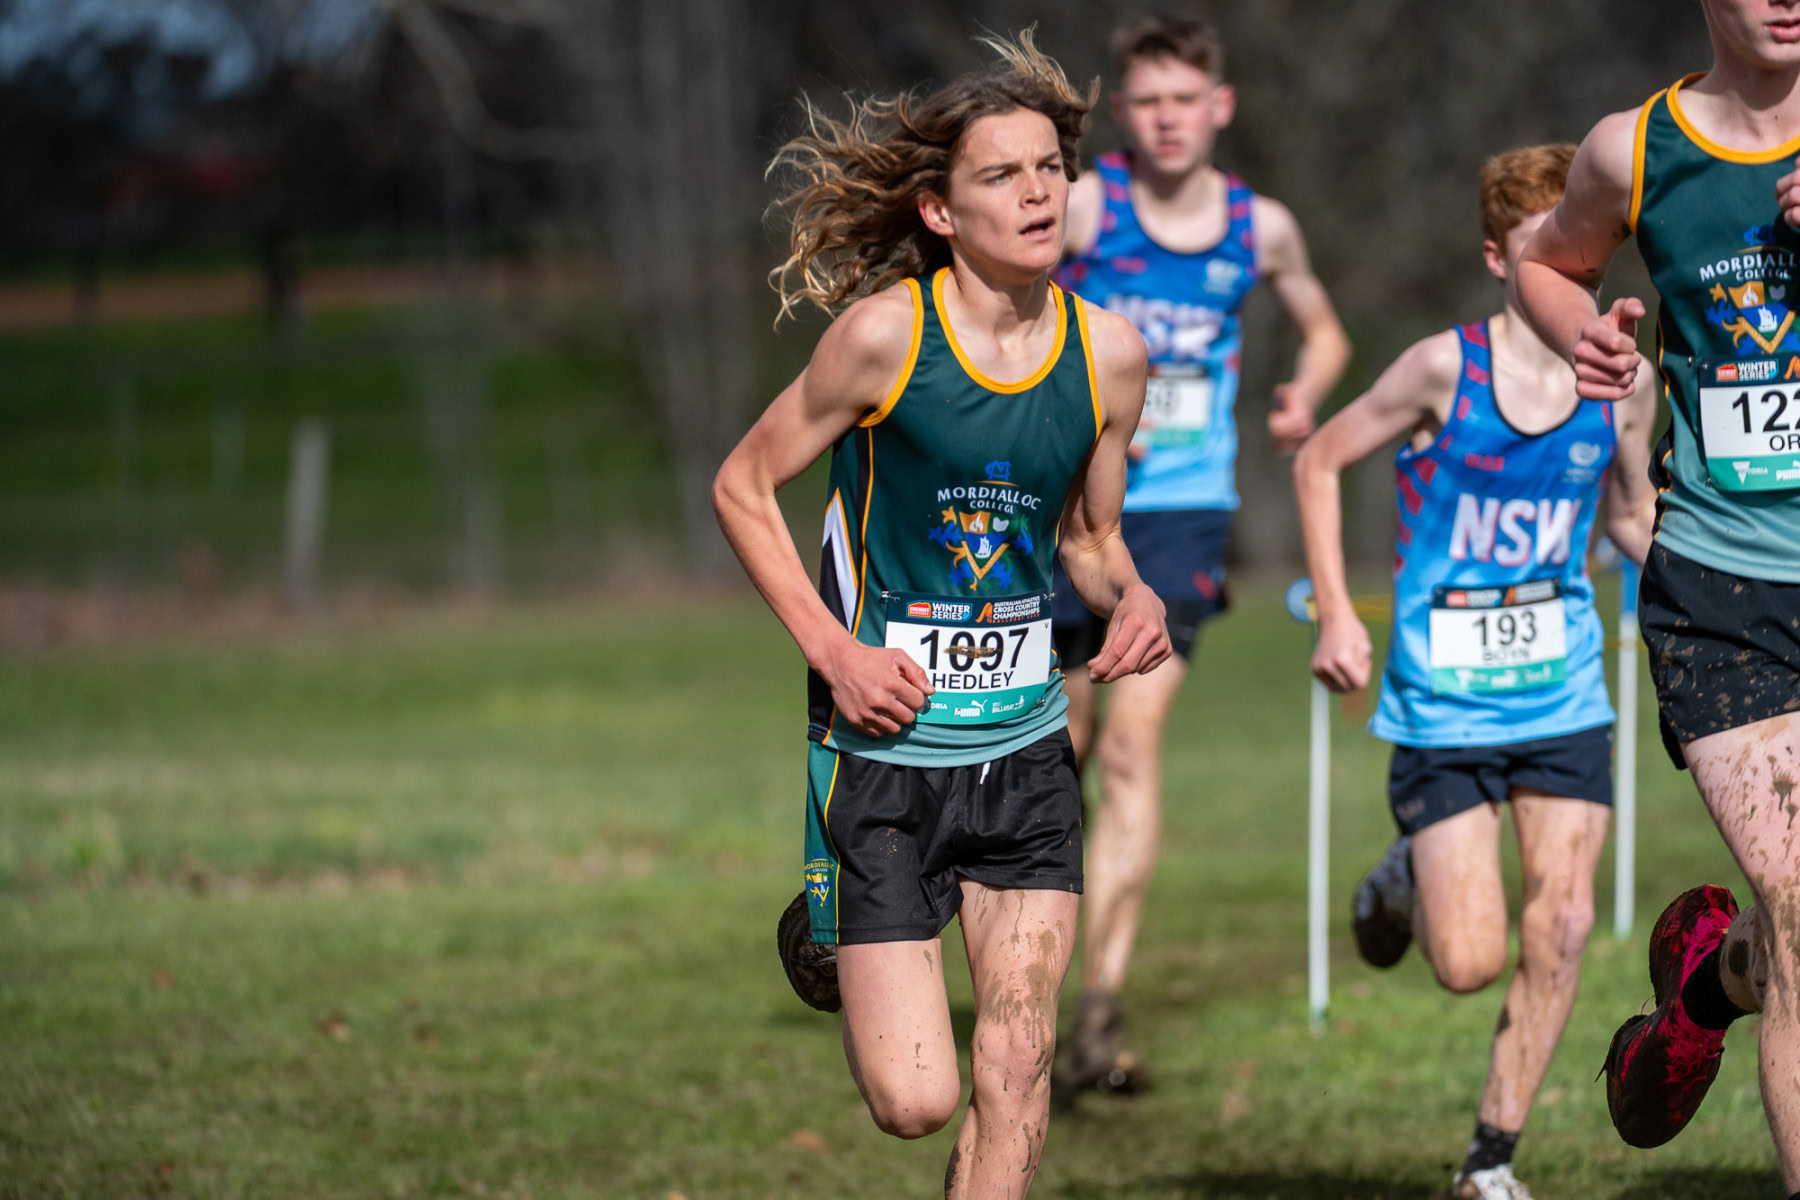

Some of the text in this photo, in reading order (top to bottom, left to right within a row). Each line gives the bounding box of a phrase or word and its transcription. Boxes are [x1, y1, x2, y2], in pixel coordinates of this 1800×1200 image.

[1738, 361, 1776, 372] WINTER
[1739, 370, 1770, 381] SERIES
[937, 486, 1042, 510] MORDIALLOC
[969, 499, 1014, 514] COLLEGE
[1449, 492, 1582, 567] NSW
[932, 602, 970, 613] WINTER
[993, 601, 1041, 613] CROSS COUNTRY
[993, 607, 1040, 620] CHAMPIONSHIPS
[932, 610, 963, 620] SERIES
[1472, 610, 1537, 646] 193
[920, 627, 1029, 672] 1097
[932, 671, 1014, 689] HEDLEY
[954, 707, 981, 717] PUMA
